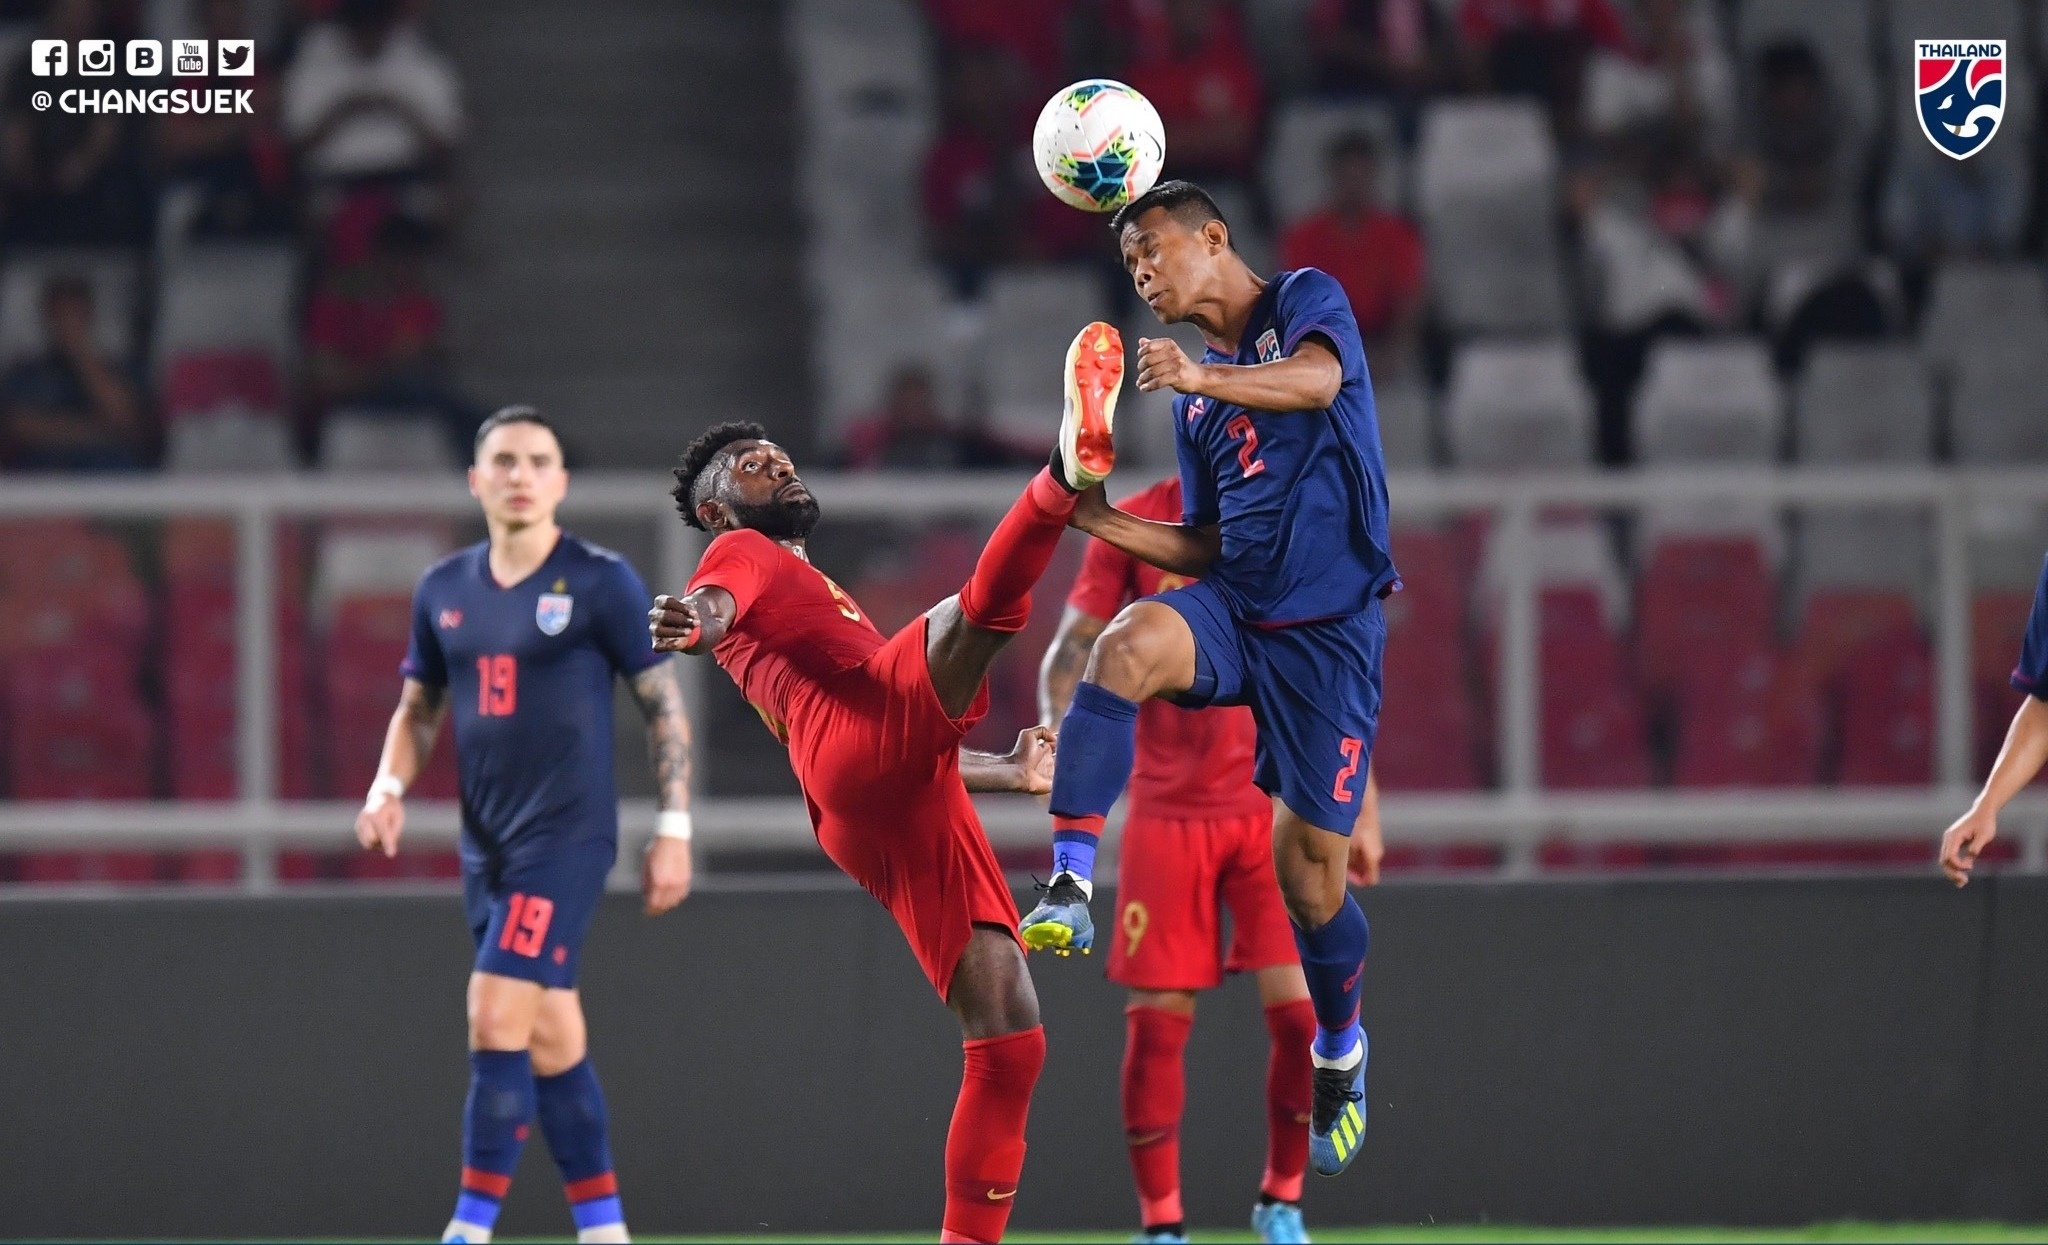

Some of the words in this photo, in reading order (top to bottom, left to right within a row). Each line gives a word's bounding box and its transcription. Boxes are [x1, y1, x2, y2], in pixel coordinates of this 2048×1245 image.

[1226, 414, 1265, 478] 2
[476, 653, 518, 717] 19
[1333, 737, 1362, 803] 2
[499, 891, 554, 959] 19
[1122, 900, 1149, 957] 9
